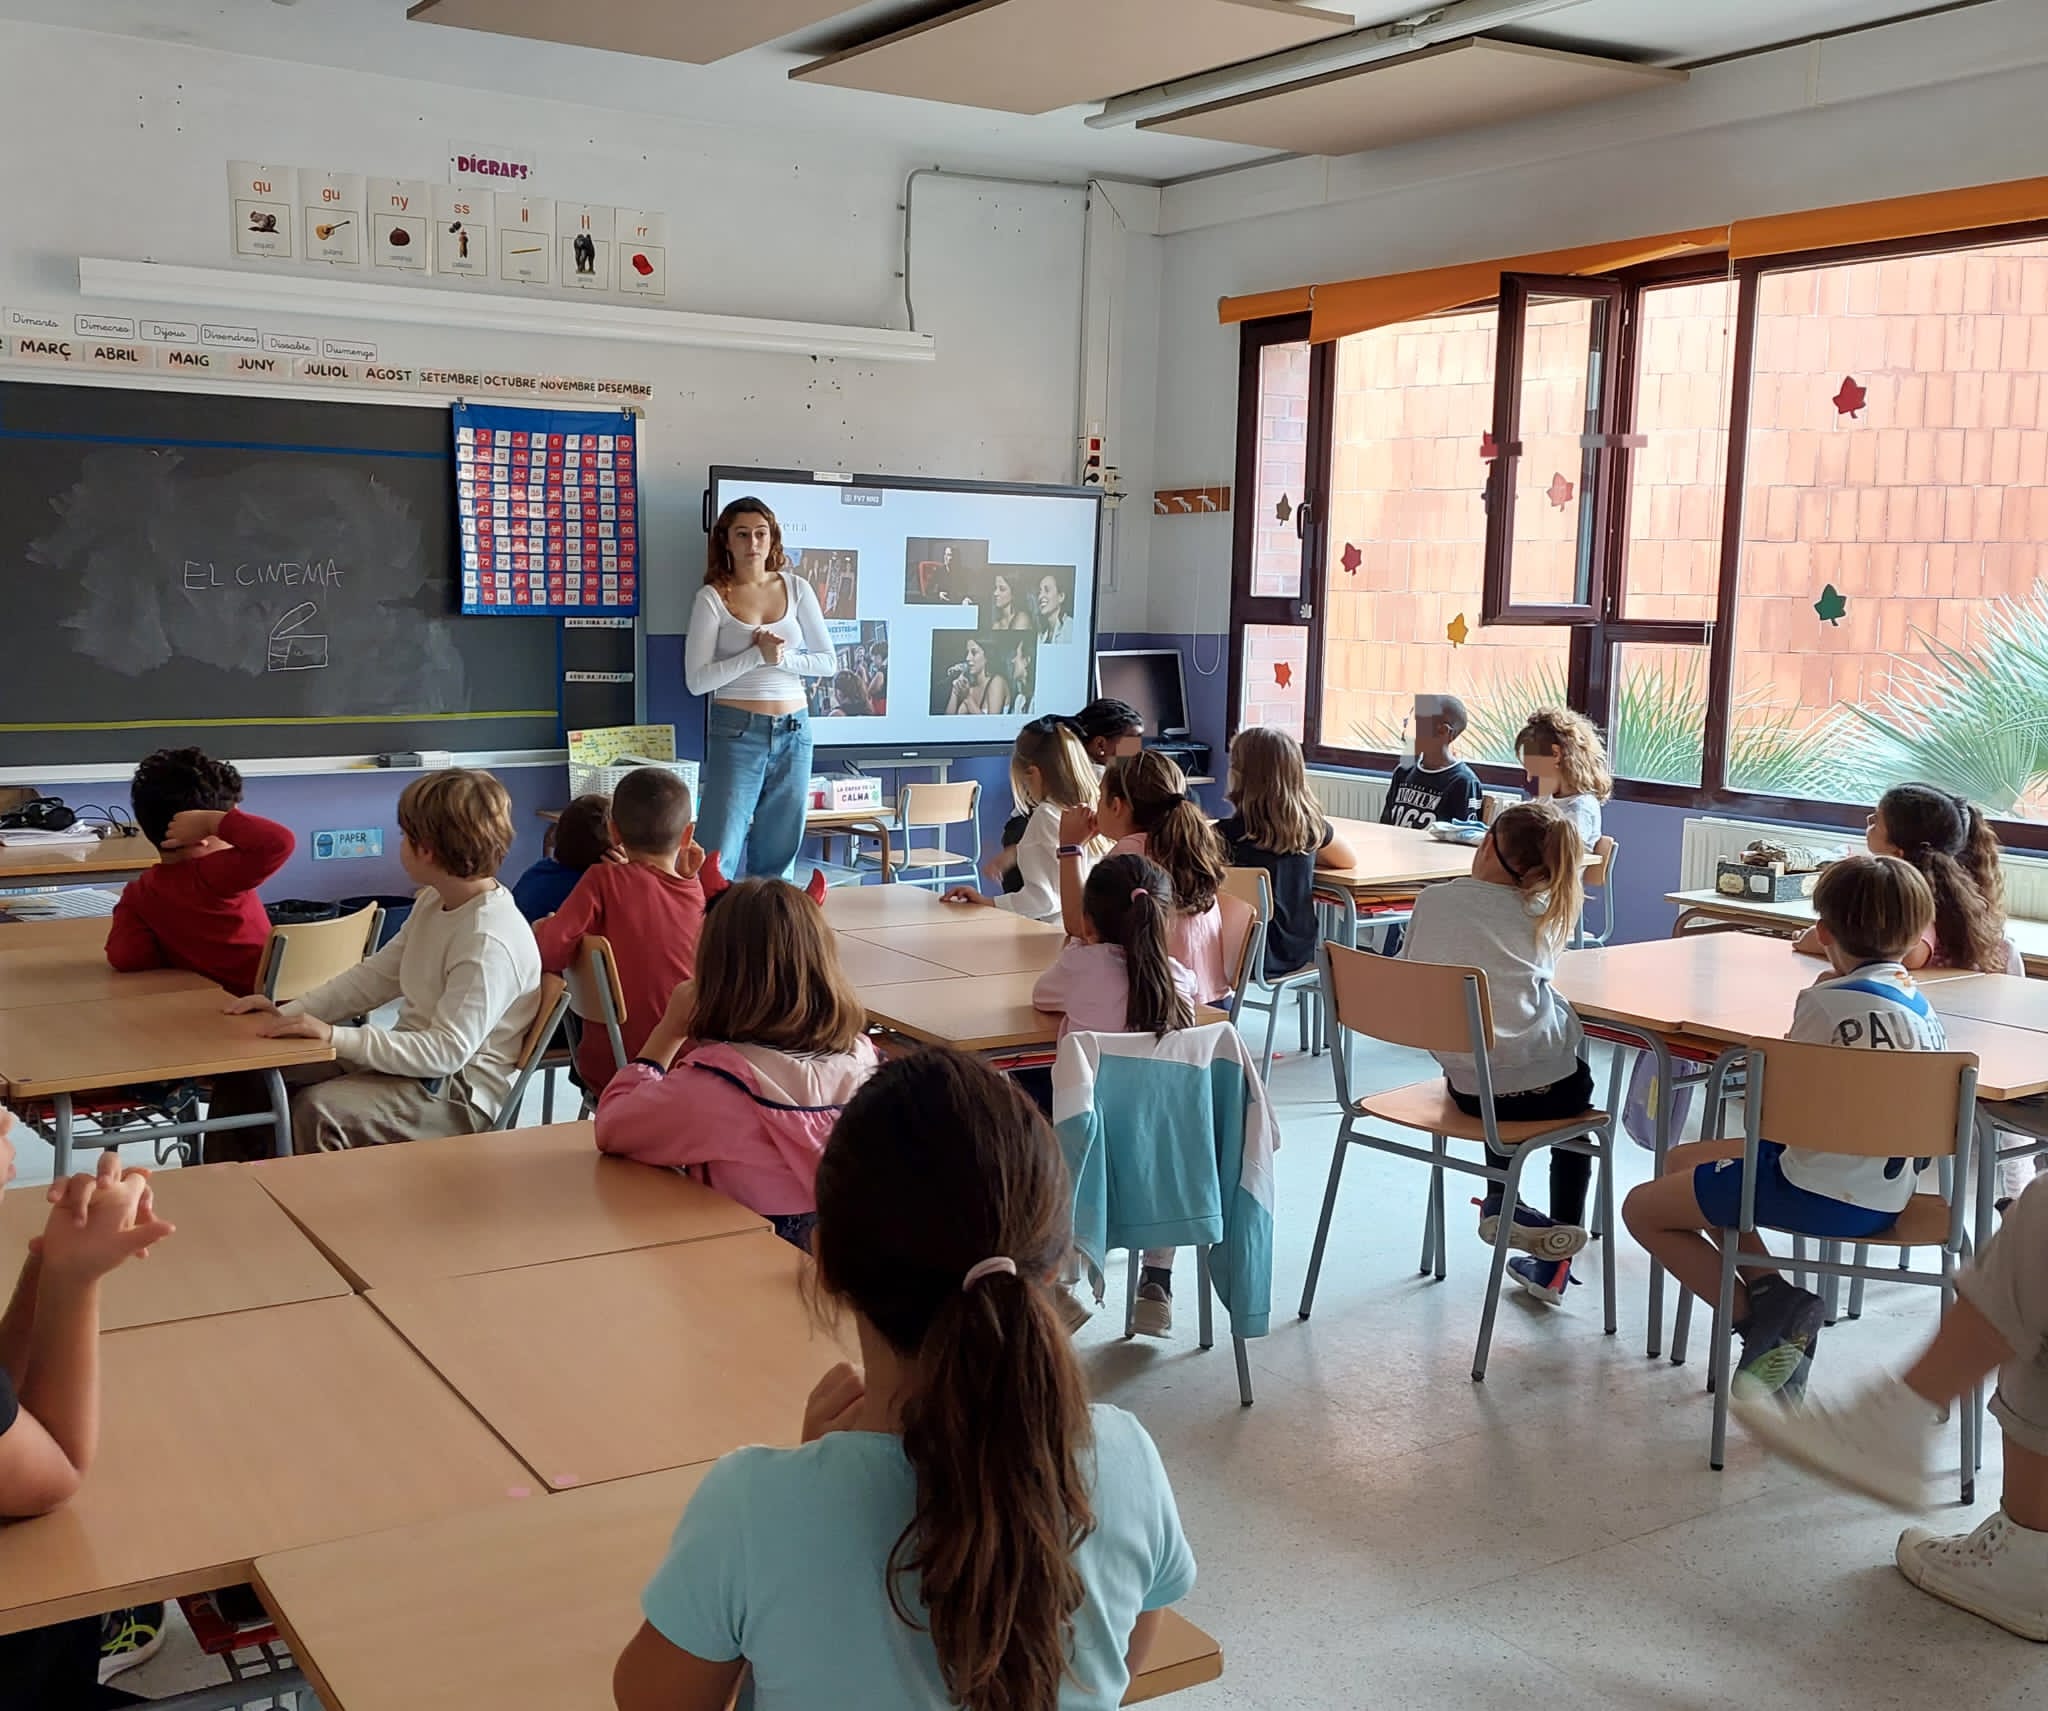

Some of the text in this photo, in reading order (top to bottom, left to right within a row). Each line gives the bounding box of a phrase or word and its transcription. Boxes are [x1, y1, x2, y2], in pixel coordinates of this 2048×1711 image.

[457, 154, 528, 179] DÍGRAFS
[252, 180, 272, 195] qu
[322, 188, 341, 202] gu
[391, 195, 409, 211] ny
[453, 203, 471, 215] ss
[637, 226, 648, 237] rr
[12, 312, 59, 328] Dimarts
[80, 319, 129, 334] Dimecres
[153, 325, 187, 341] Dijous
[20, 339, 652, 396] MARÇ ABRIL MAIG JUNY JULIOL AGOST SETEMBRE OCTUBRE NOVEMBRE DESEMBRE
[184, 558, 345, 590] EL CINEMA
[842, 792, 869, 802] CALMA
[339, 832, 367, 845] PAPER
